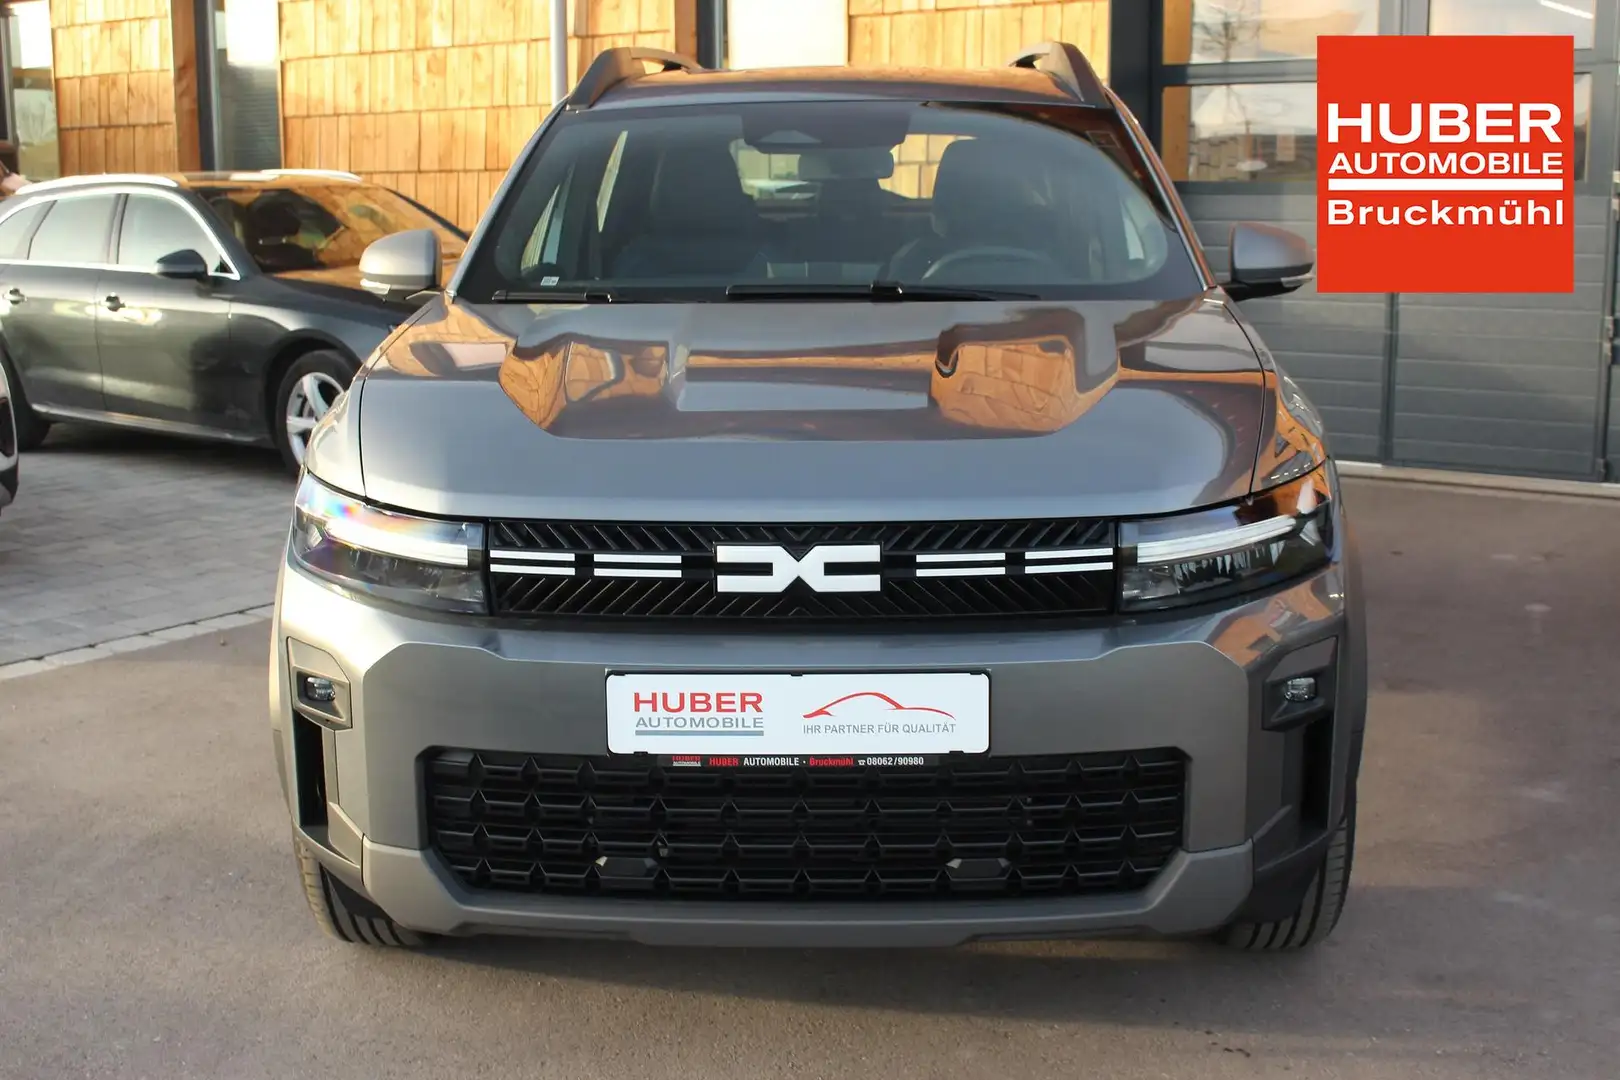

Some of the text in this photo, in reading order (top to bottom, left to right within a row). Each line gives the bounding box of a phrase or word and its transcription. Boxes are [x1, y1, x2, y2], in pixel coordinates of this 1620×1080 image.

[634, 692, 763, 713] HUBER
[635, 717, 764, 729] AUTOMOBILE
[803, 721, 956, 734] IHR PARTNER FÜR QUALITÄT
[709, 757, 738, 766] HUBER
[743, 757, 800, 766] AUTOMOBILE
[809, 757, 854, 766] Bruckmühl
[866, 757, 924, 765] 08062/90980
